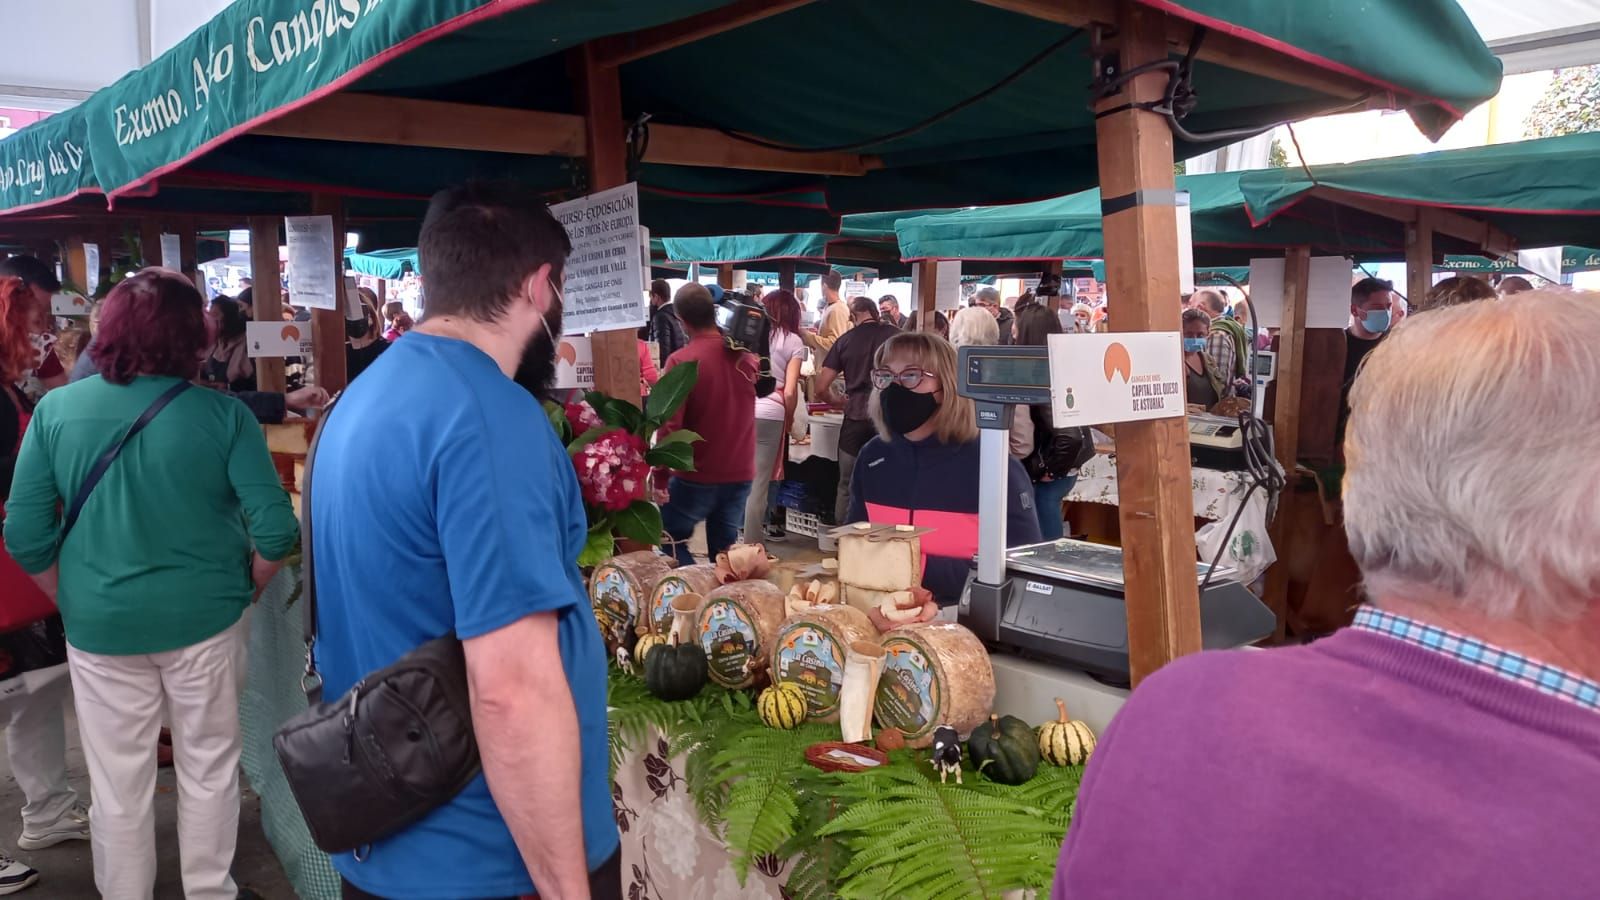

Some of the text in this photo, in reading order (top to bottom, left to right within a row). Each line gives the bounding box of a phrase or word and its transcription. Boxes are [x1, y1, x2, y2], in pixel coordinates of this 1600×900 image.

[115, 92, 189, 146] Excmo.
[246, 0, 361, 74] Cangas
[558, 195, 635, 226] CURSO-EXPOSICIÓN
[1131, 382, 1179, 397] CAPITAL DEL QUESO
[1132, 396, 1165, 411] DE ASTURIAS
[801, 653, 825, 668] Casina
[900, 670, 921, 694] Casina
